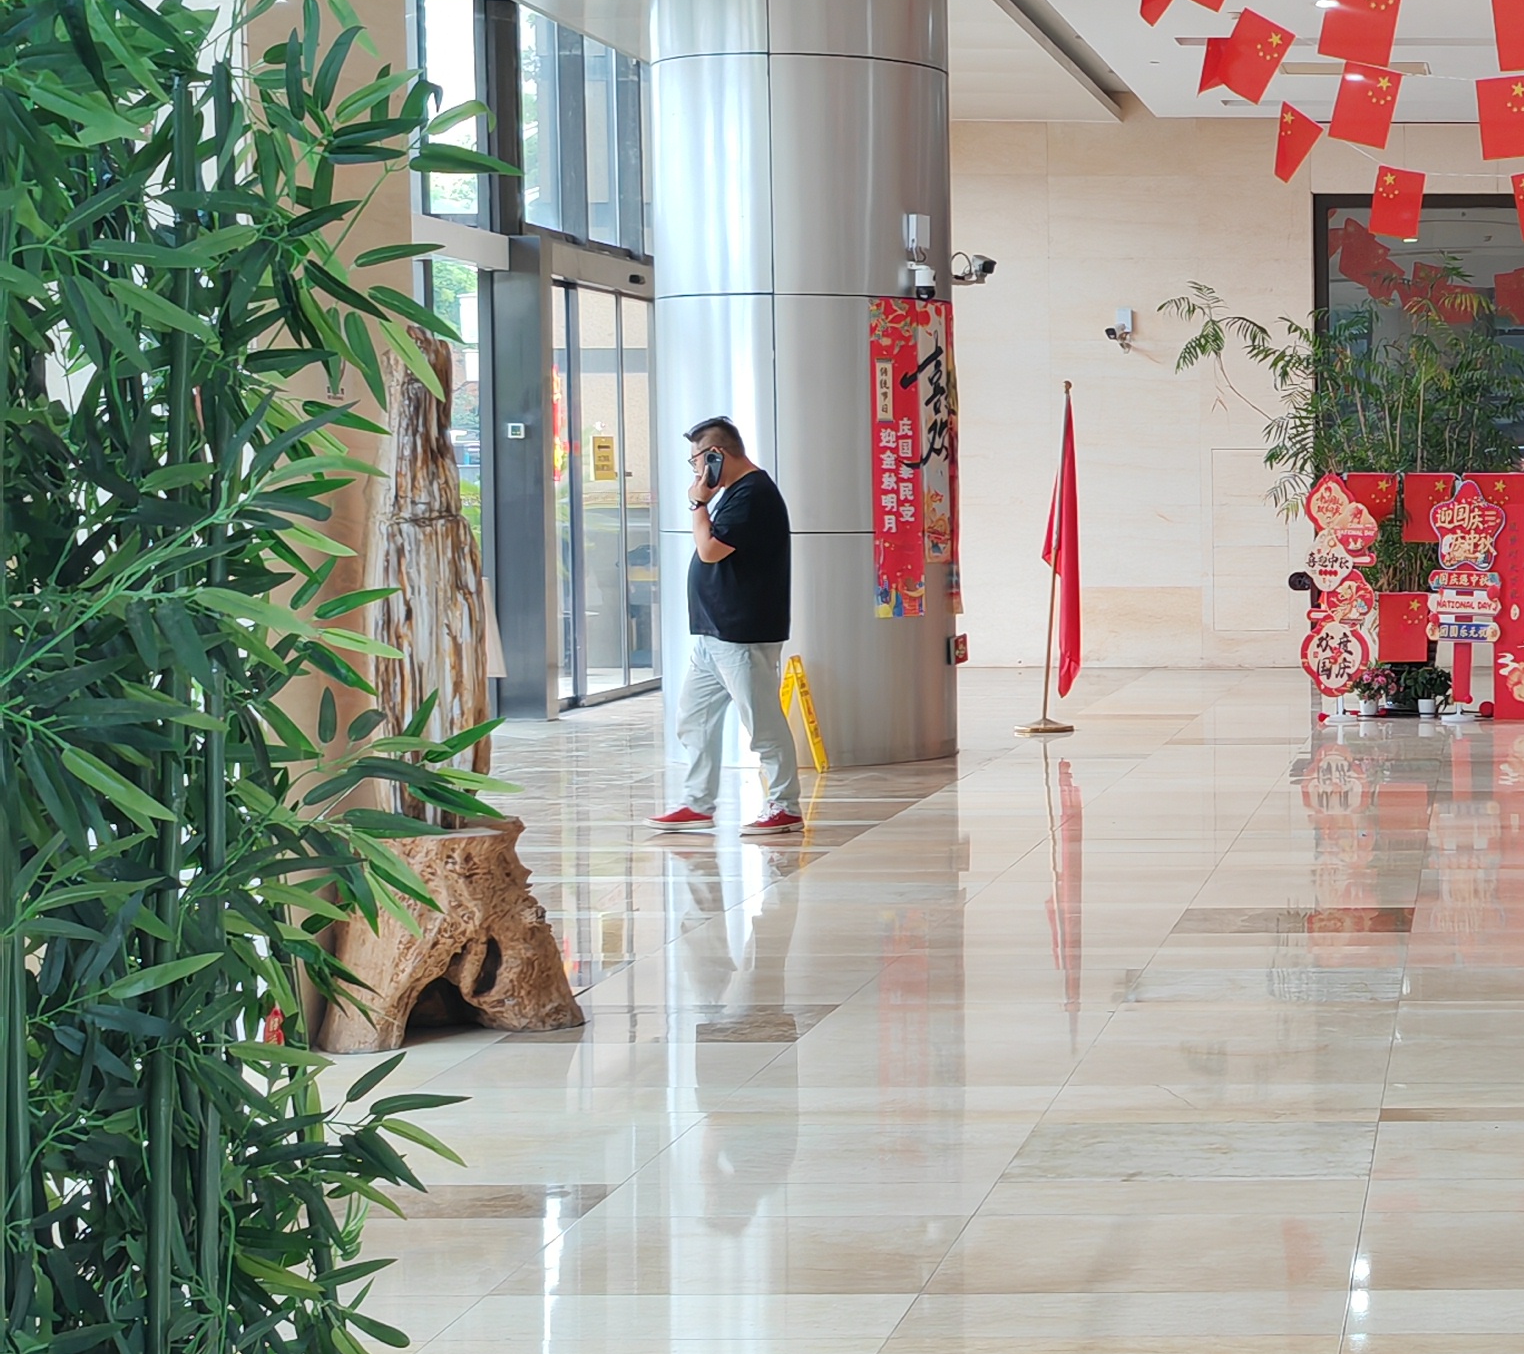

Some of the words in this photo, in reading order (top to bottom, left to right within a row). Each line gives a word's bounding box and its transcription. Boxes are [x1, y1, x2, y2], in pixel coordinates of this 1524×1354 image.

[879, 428, 898, 534] 迎金秋明月
[1435, 504, 1484, 531] 迎国庆
[1450, 531, 1497, 556] 庆中秋
[1436, 600, 1475, 610] NATIONAL
[1478, 601, 1492, 611] DAY
[1316, 632, 1354, 656] 欢度
[1317, 657, 1353, 680] 国庆
